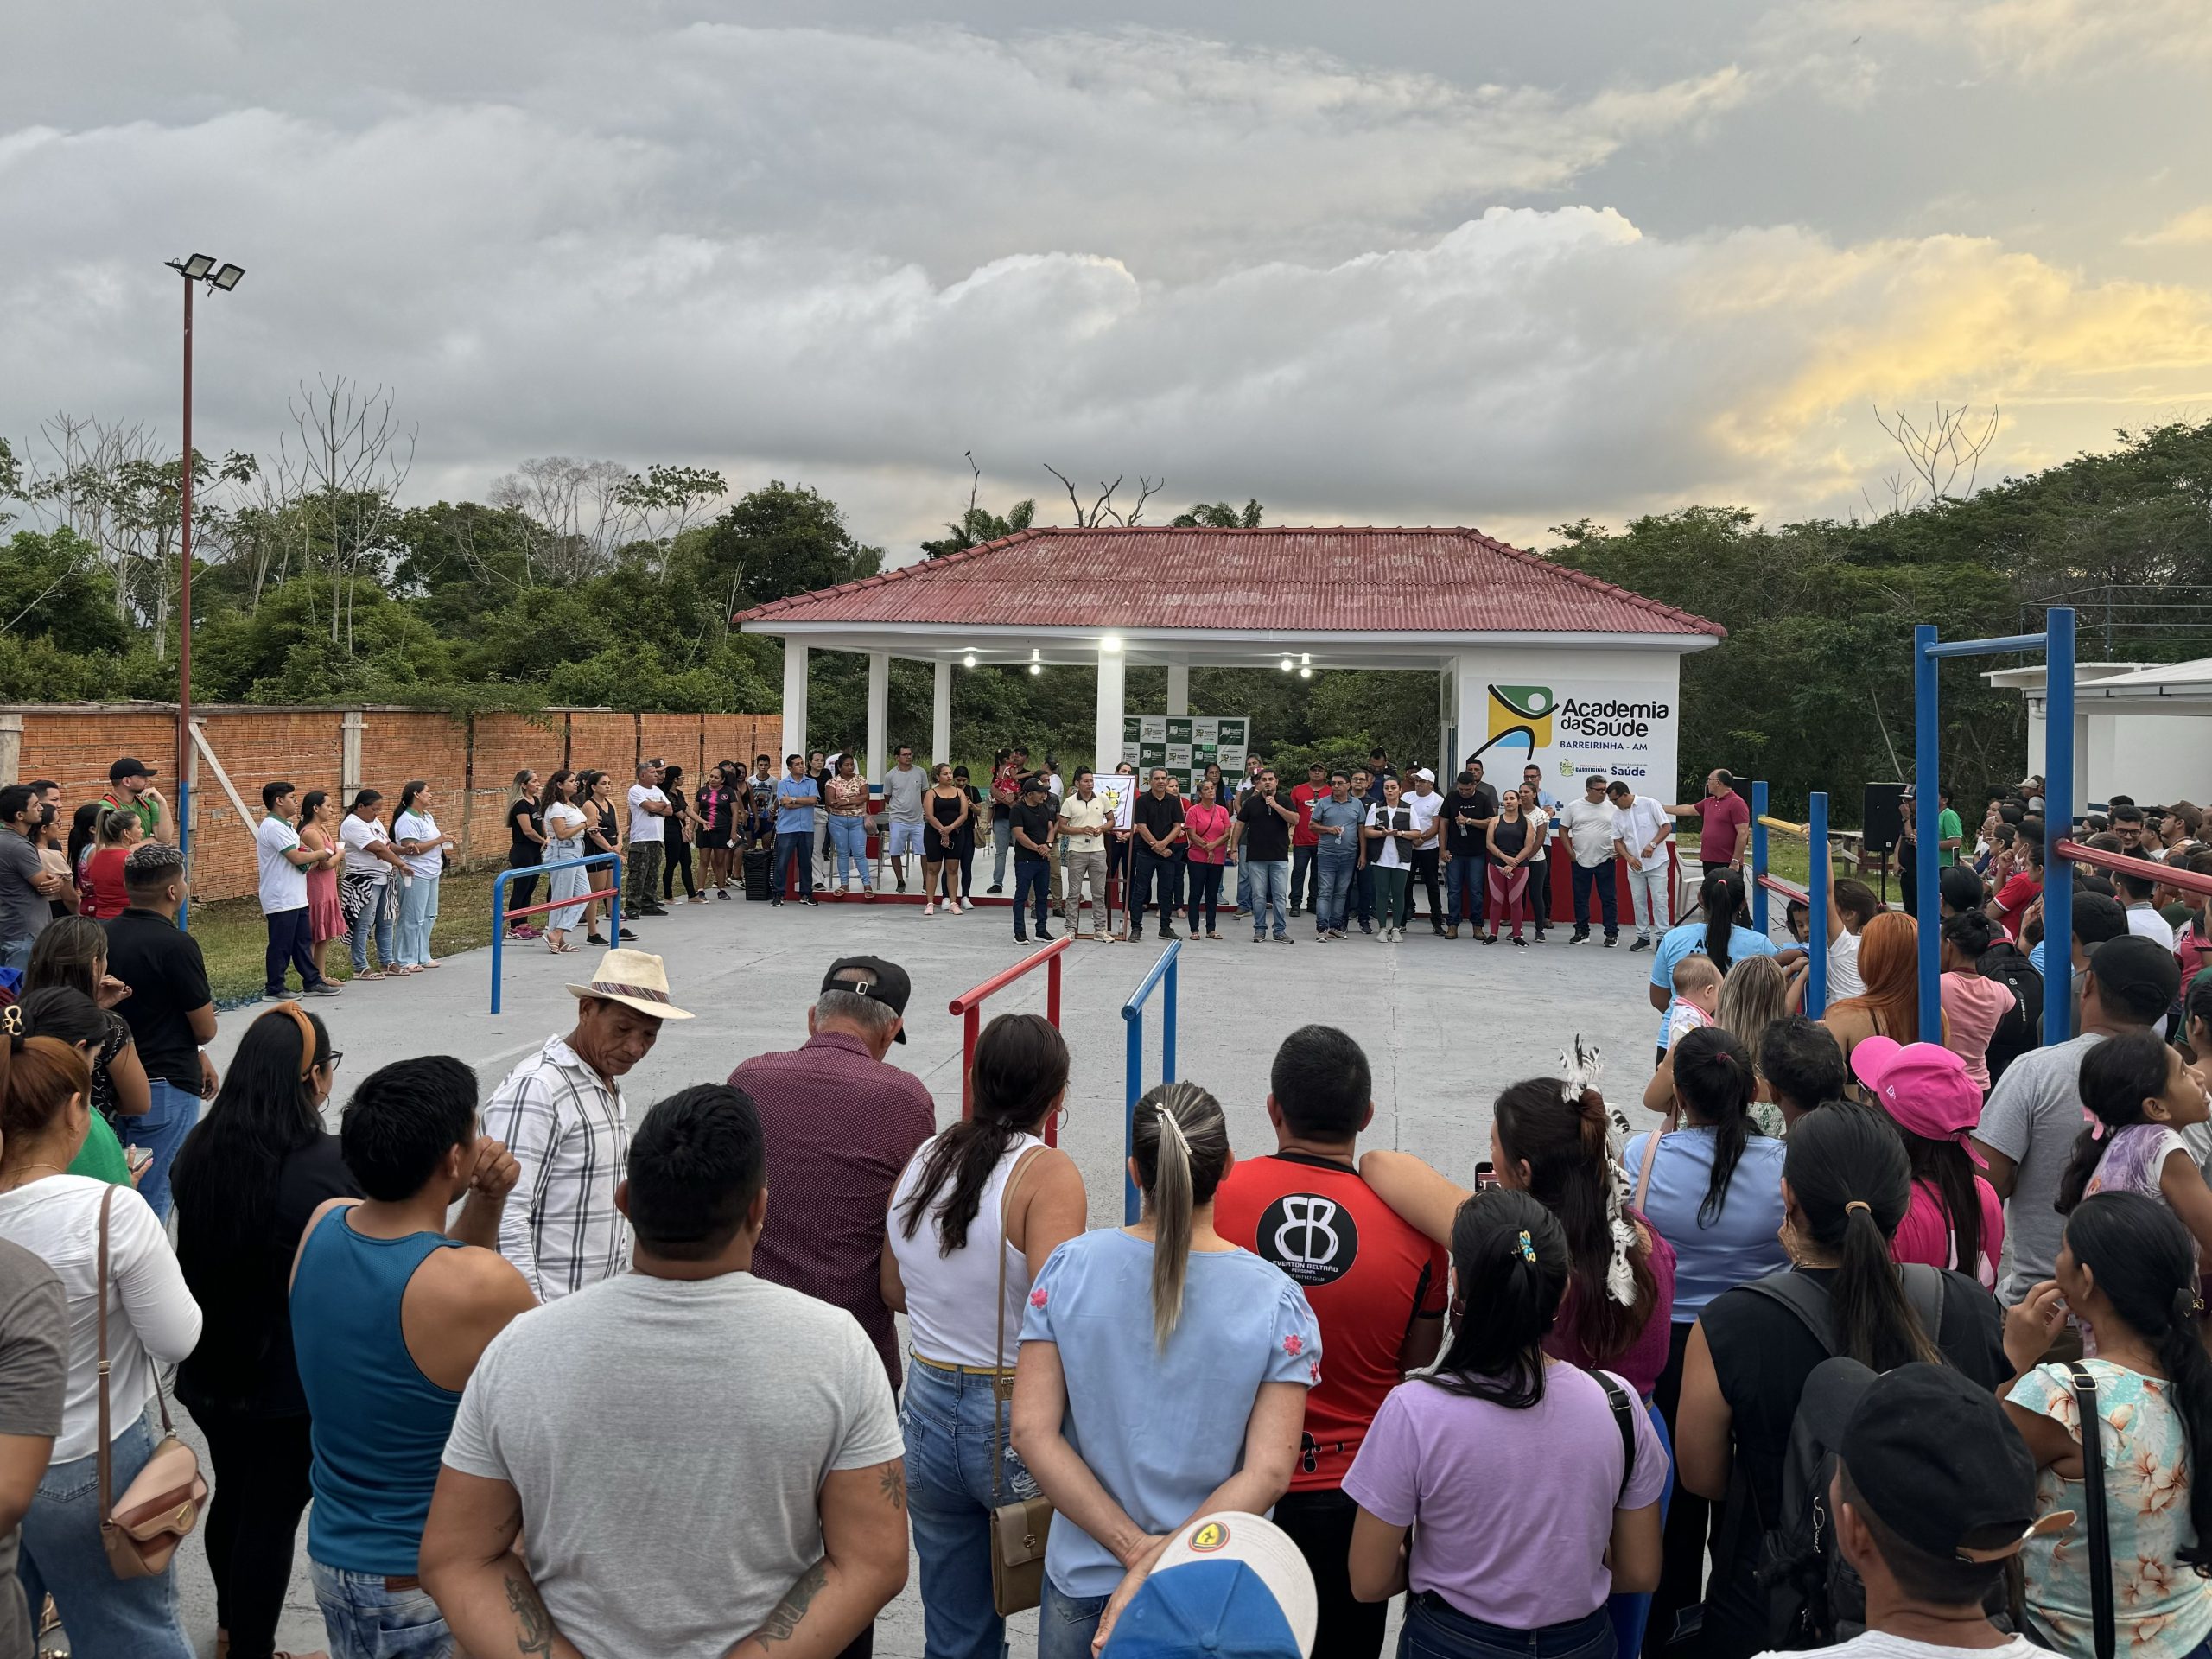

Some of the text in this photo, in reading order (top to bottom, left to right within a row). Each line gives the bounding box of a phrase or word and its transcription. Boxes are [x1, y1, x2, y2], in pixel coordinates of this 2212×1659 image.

[1561, 698, 1669, 719] Academia
[1560, 741, 1624, 750] BARREIRINHA
[1611, 766, 1646, 776] Saúde
[1273, 1260, 1305, 1268] EVERTON
